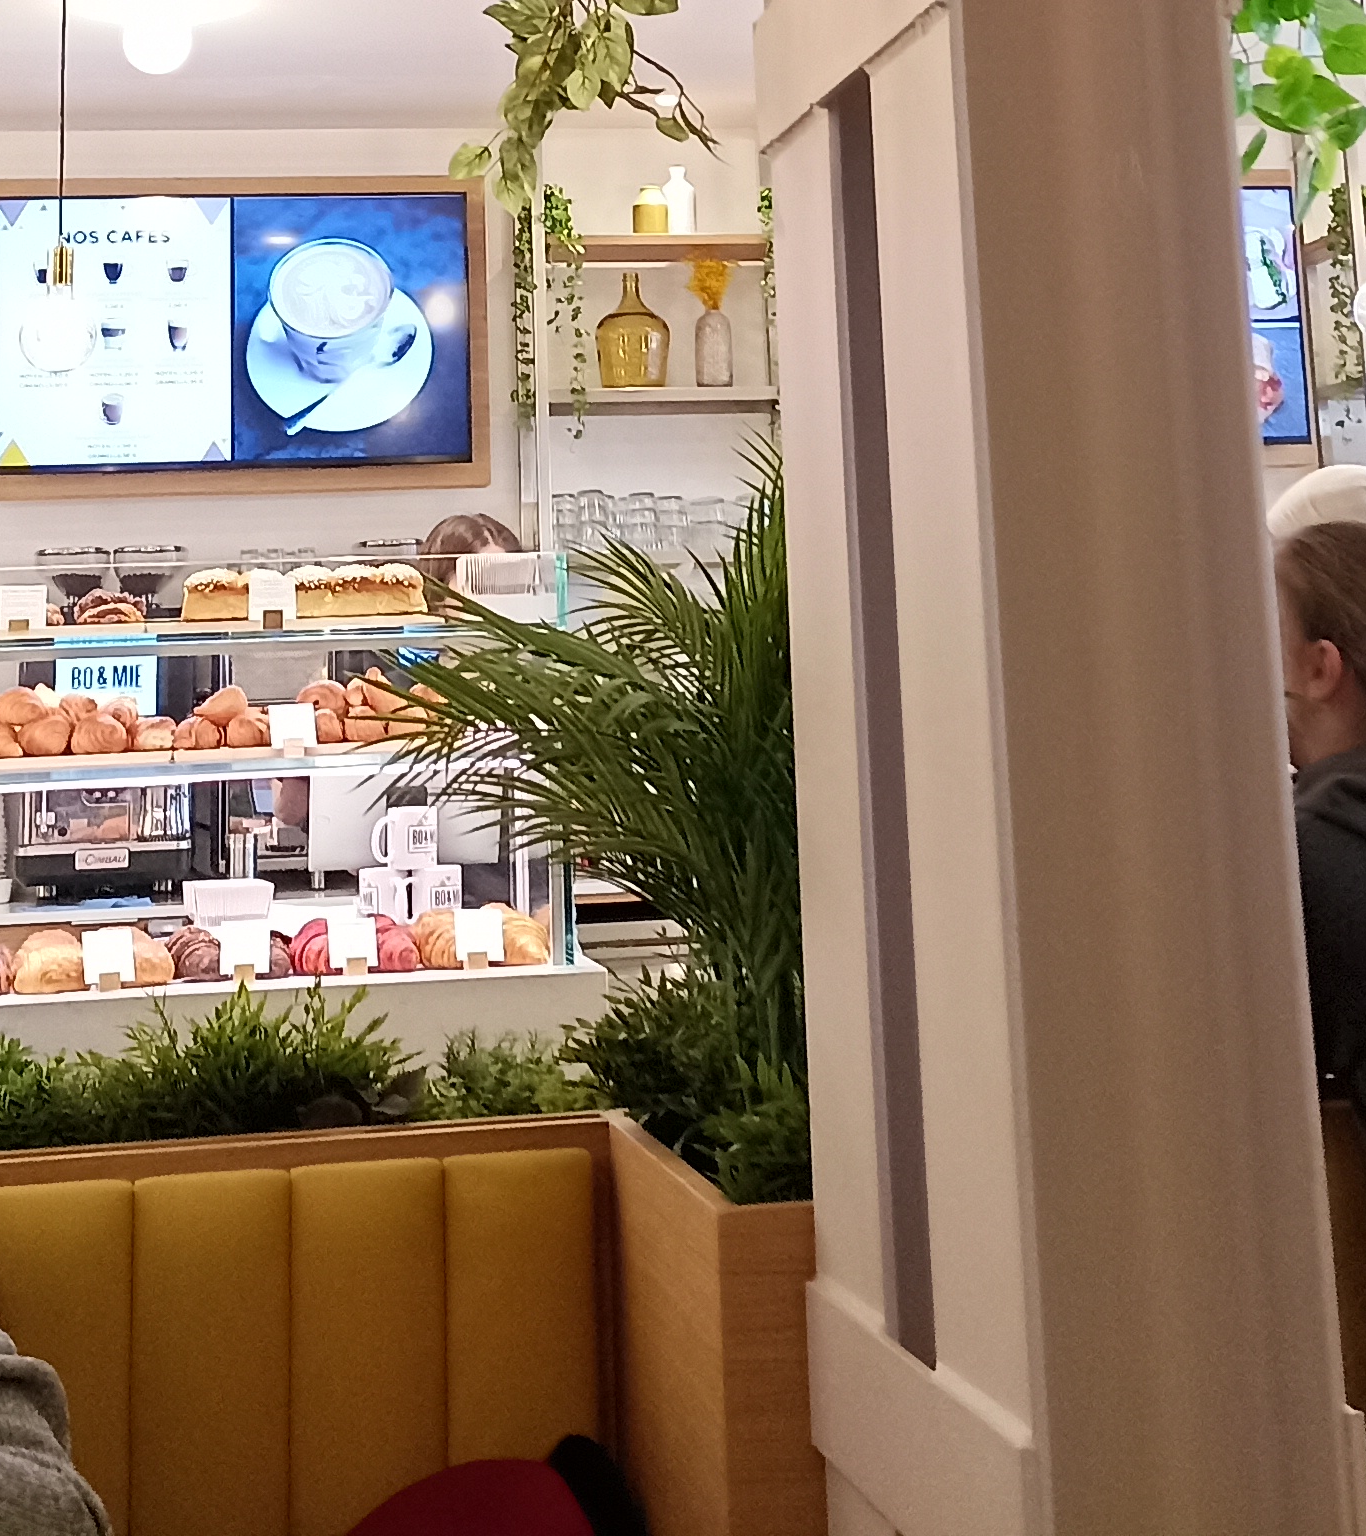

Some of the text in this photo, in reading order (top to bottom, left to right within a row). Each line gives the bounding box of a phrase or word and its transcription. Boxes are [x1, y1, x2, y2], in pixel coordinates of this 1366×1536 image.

[61, 230, 99, 244] NOS
[71, 664, 142, 690] BO & MIE
[435, 889, 446, 906] BO
